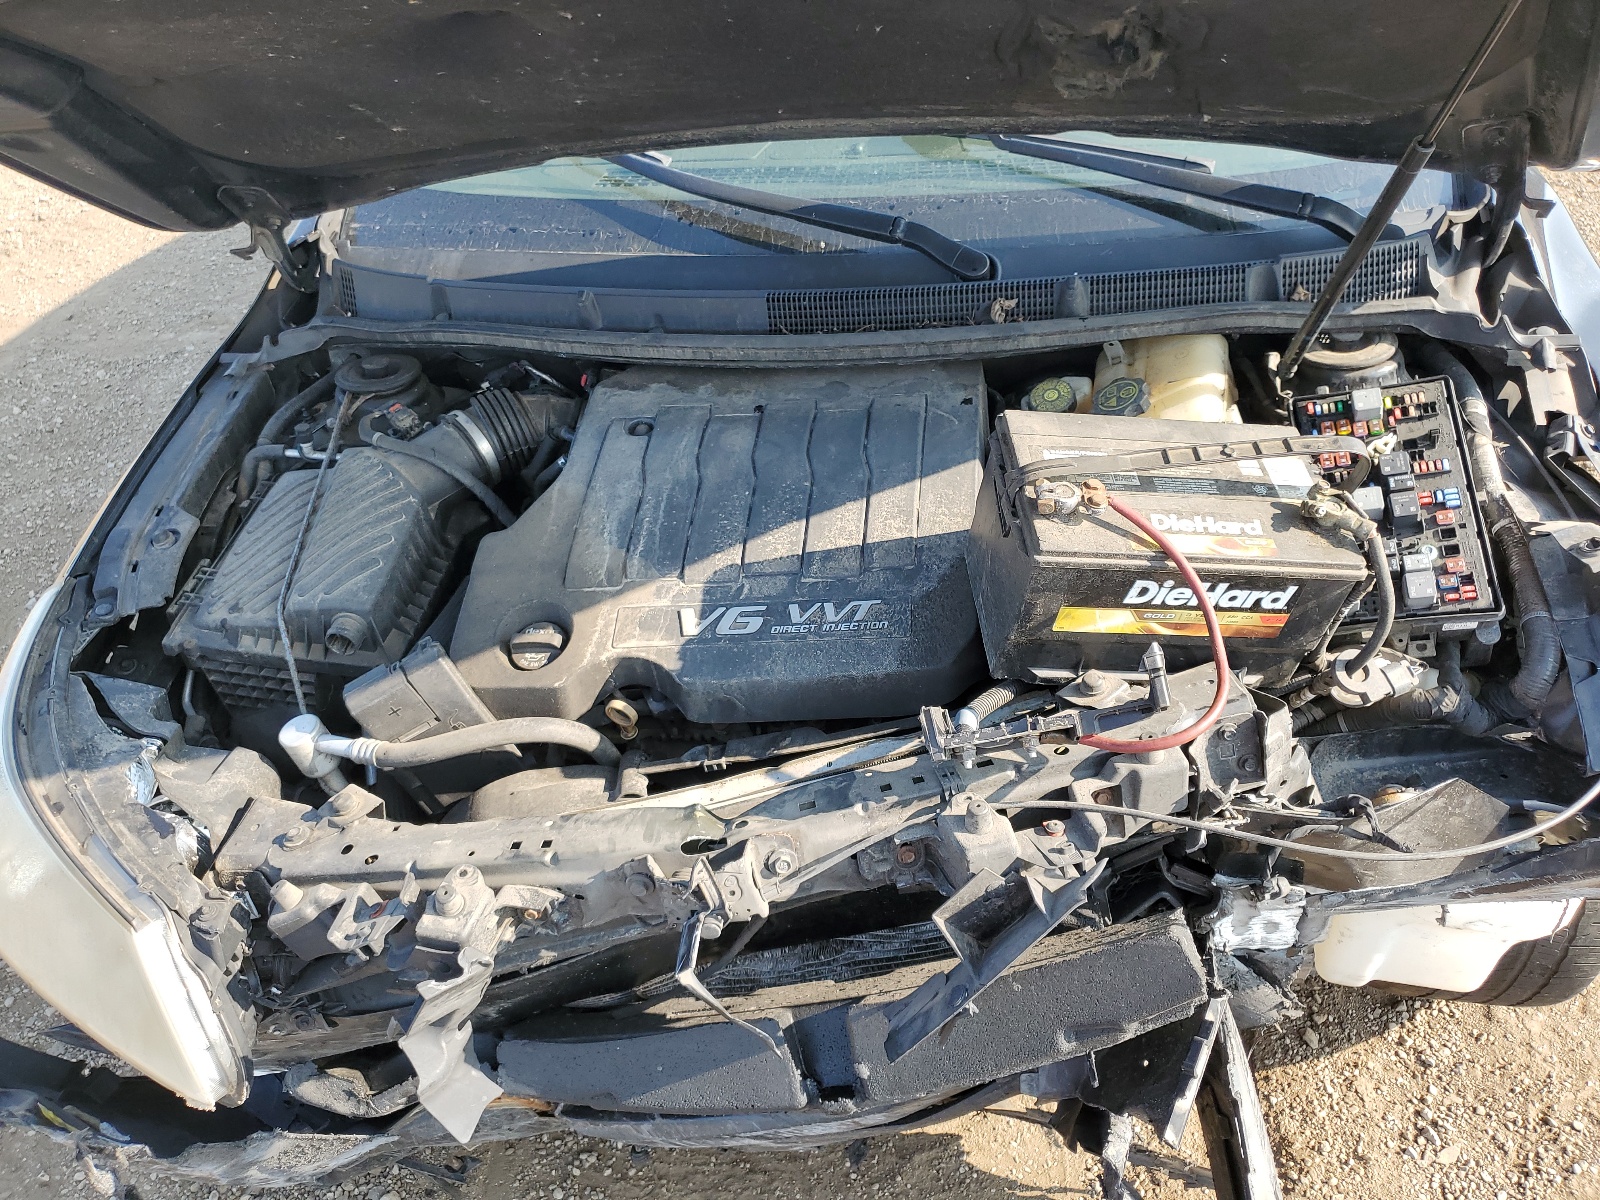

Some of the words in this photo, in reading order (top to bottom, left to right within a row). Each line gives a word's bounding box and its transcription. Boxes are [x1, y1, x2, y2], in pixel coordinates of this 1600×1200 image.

[1150, 513, 1264, 536] DieHard
[1123, 579, 1299, 610] DieHard
[678, 605, 767, 638] V6
[788, 600, 882, 624] VVT
[1143, 612, 1176, 620] GOLD
[770, 624, 818, 635] DIRECT
[822, 621, 889, 634] INJECTION
